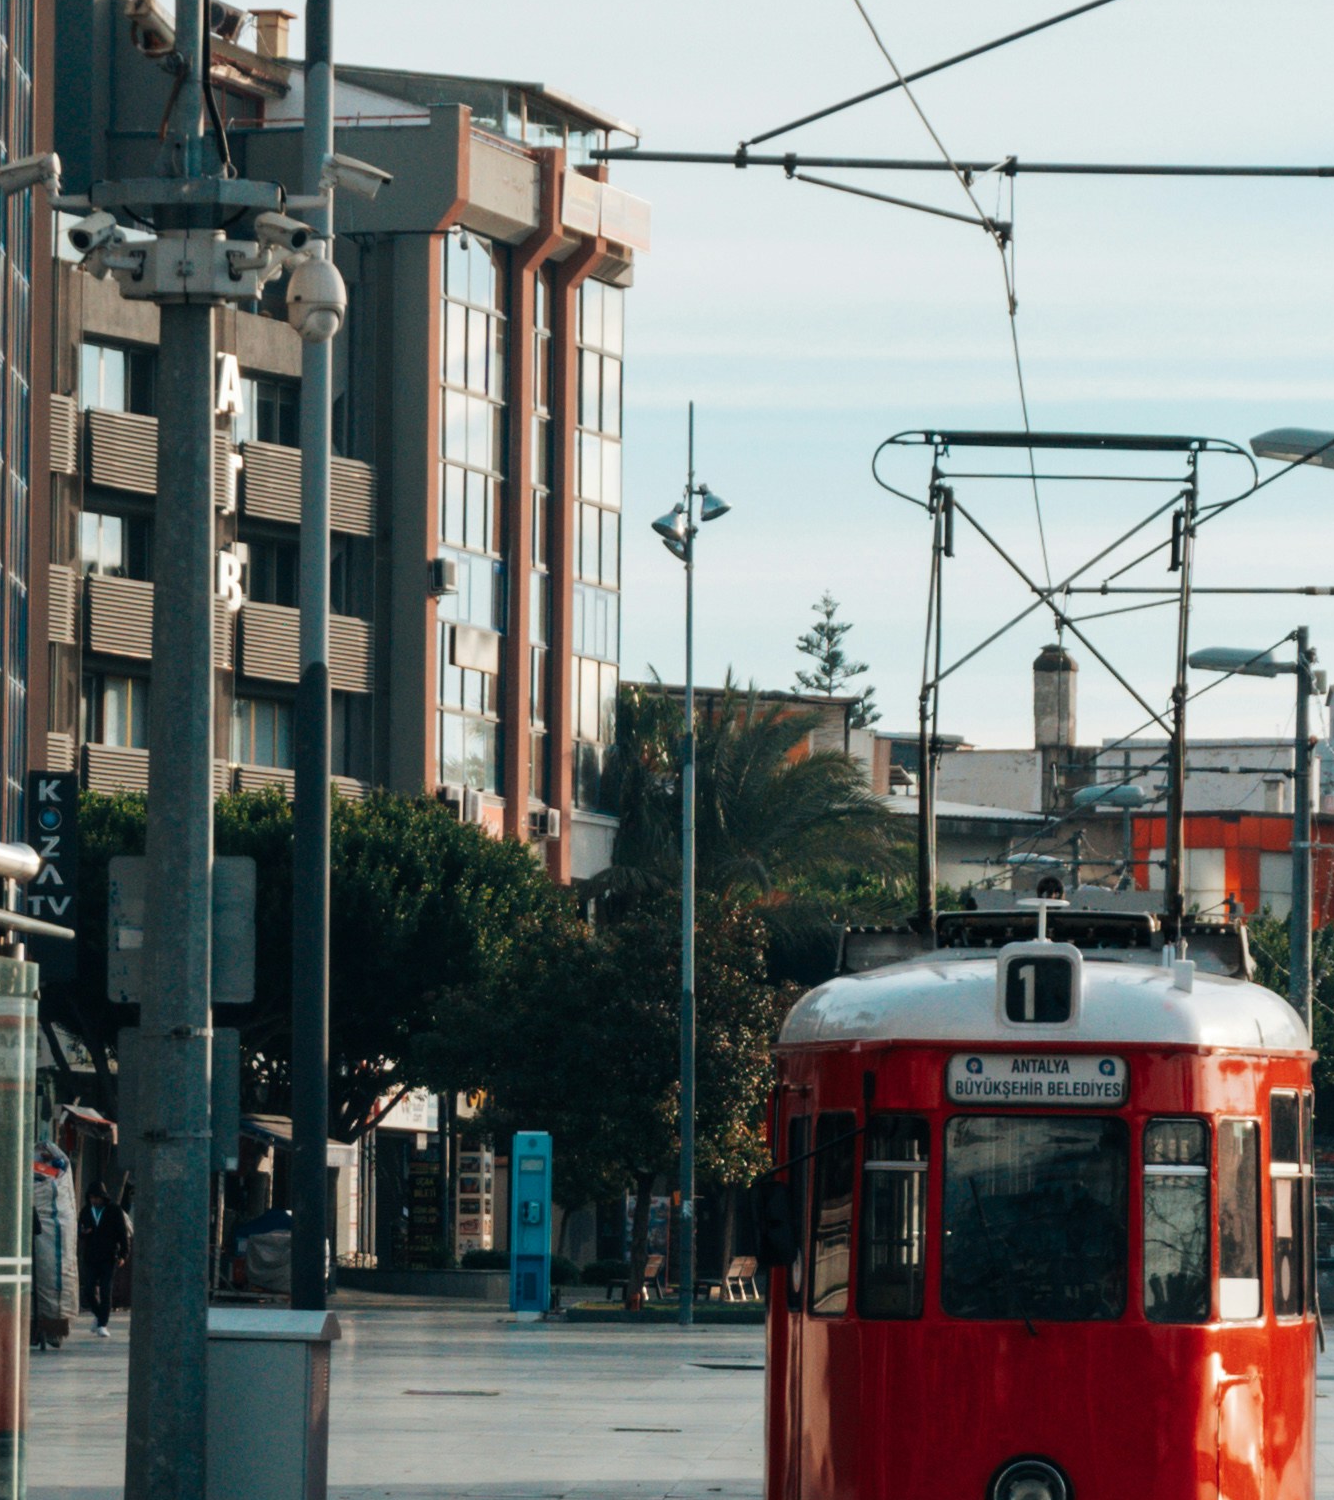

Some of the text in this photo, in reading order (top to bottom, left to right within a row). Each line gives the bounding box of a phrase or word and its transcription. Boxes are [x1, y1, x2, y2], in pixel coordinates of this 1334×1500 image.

[27, 894, 72, 917] TV
[1019, 964, 1036, 1021] 1
[1011, 1058, 1070, 1074] ANTALYA
[955, 1077, 1043, 1099] BÜYÜKŞEHİR
